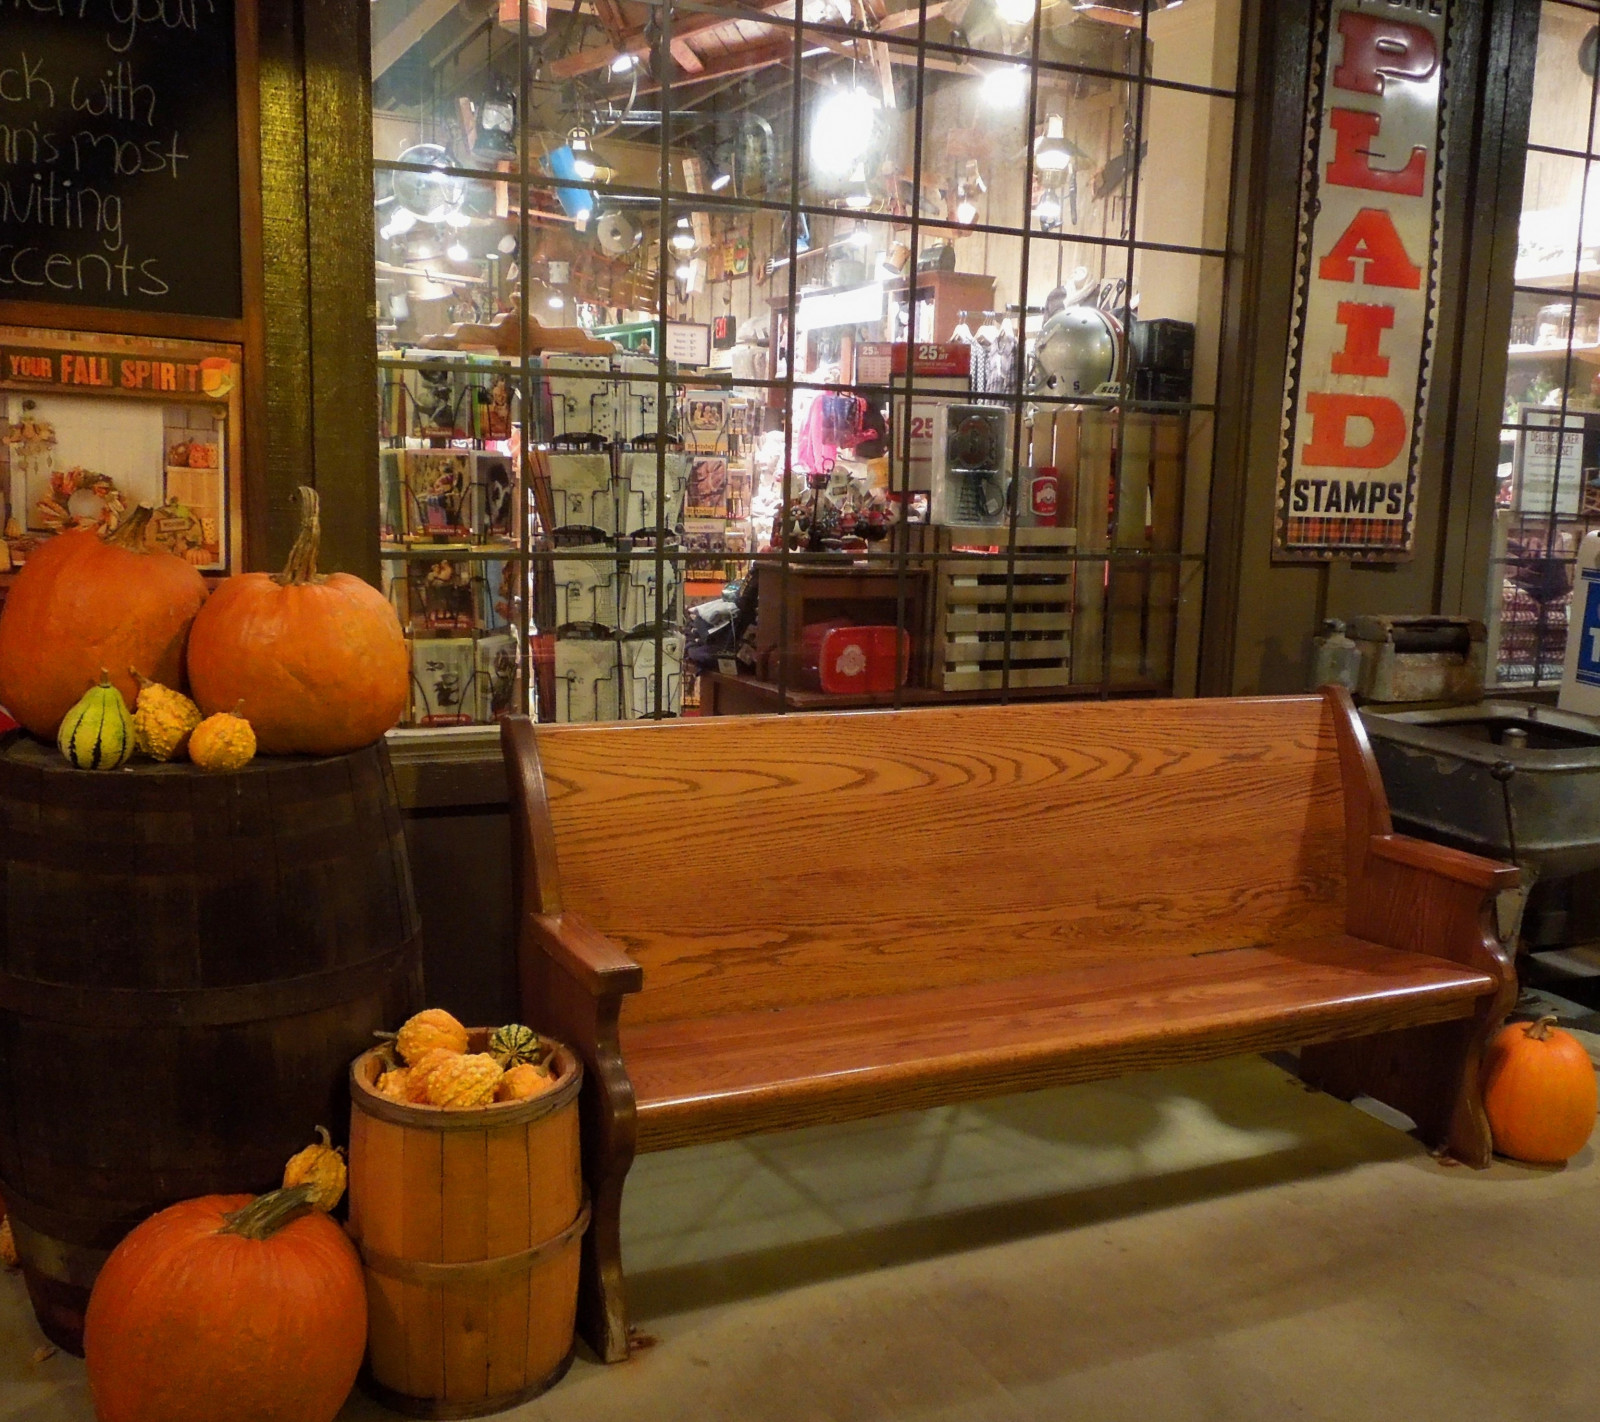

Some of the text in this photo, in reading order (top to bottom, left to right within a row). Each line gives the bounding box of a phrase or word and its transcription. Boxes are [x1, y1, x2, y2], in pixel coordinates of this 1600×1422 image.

[71, 60, 156, 127] with
[72, 130, 190, 179] most
[1300, 9, 1438, 469] PLAID
[9, 354, 200, 392] YOUR FALL SPIRIT
[1292, 478, 1403, 515] STAMPS
